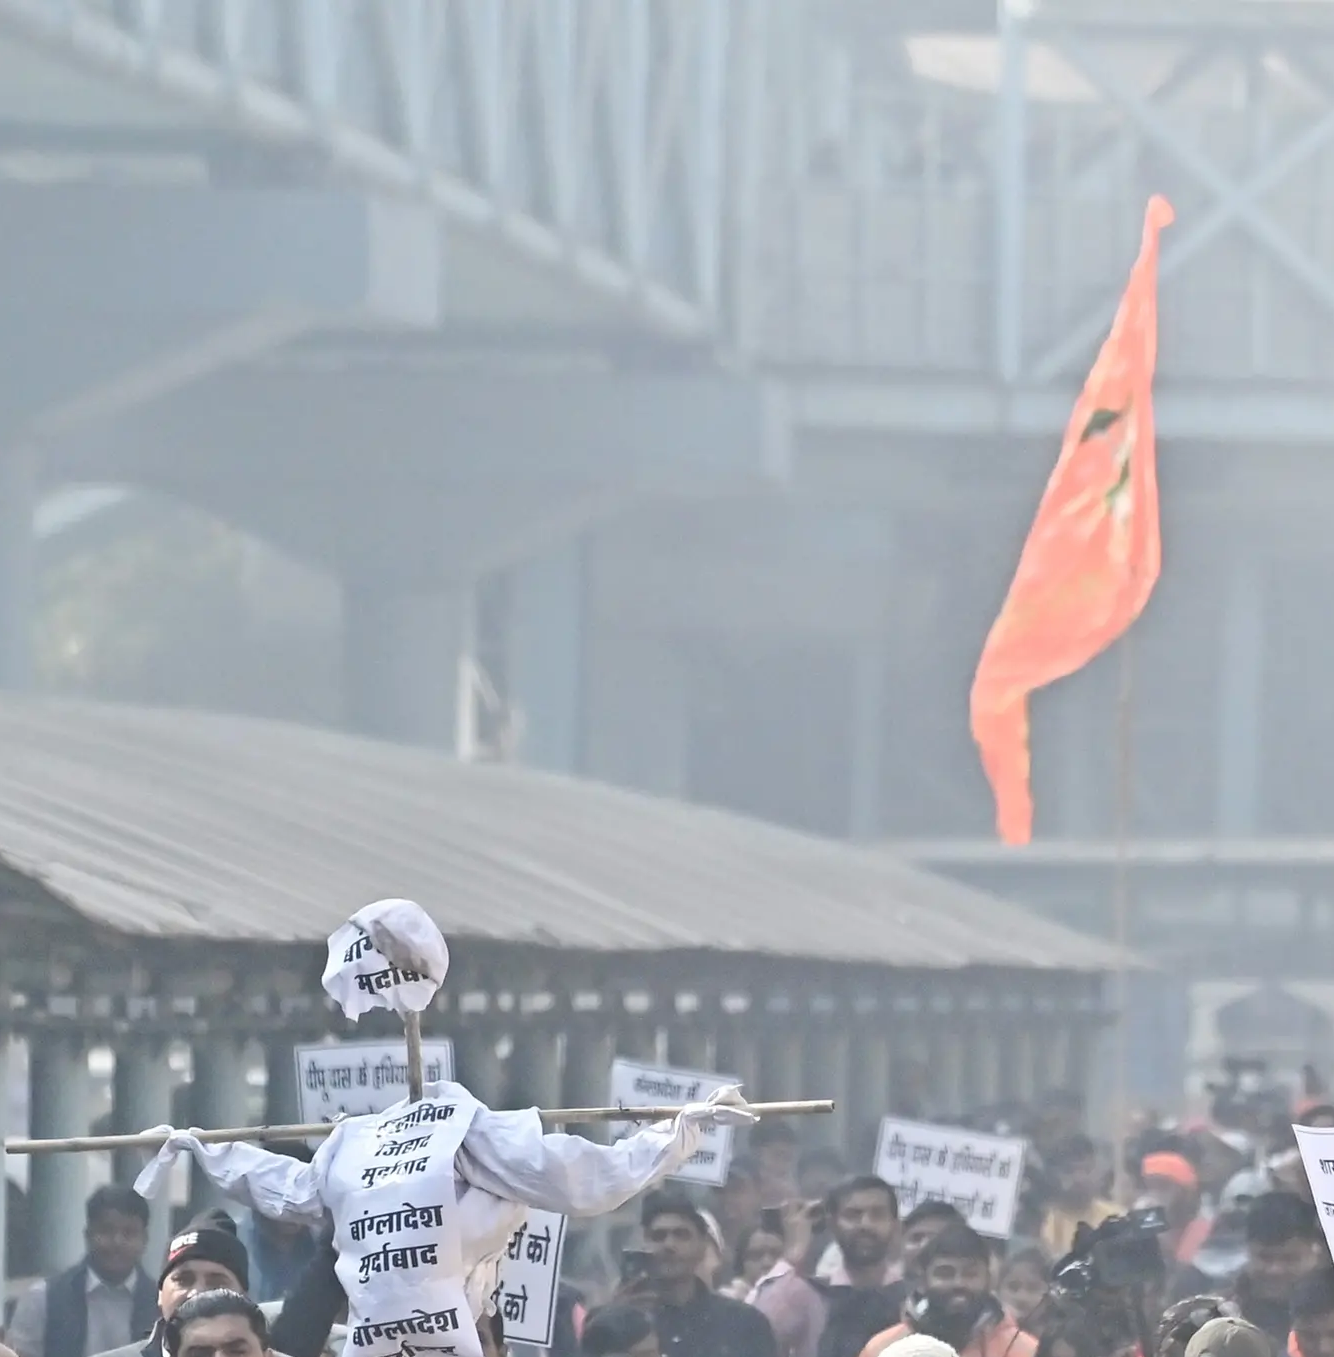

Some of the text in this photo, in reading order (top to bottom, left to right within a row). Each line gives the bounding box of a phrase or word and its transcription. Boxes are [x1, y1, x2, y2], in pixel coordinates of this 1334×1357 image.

[349, 1202, 444, 1242] बांग्लादेश
[358, 1242, 438, 1284] मुर्दाबाद
[527, 1225, 551, 1266] को
[504, 1284, 528, 1324] को
[352, 1308, 460, 1347] बांग्लादेश
